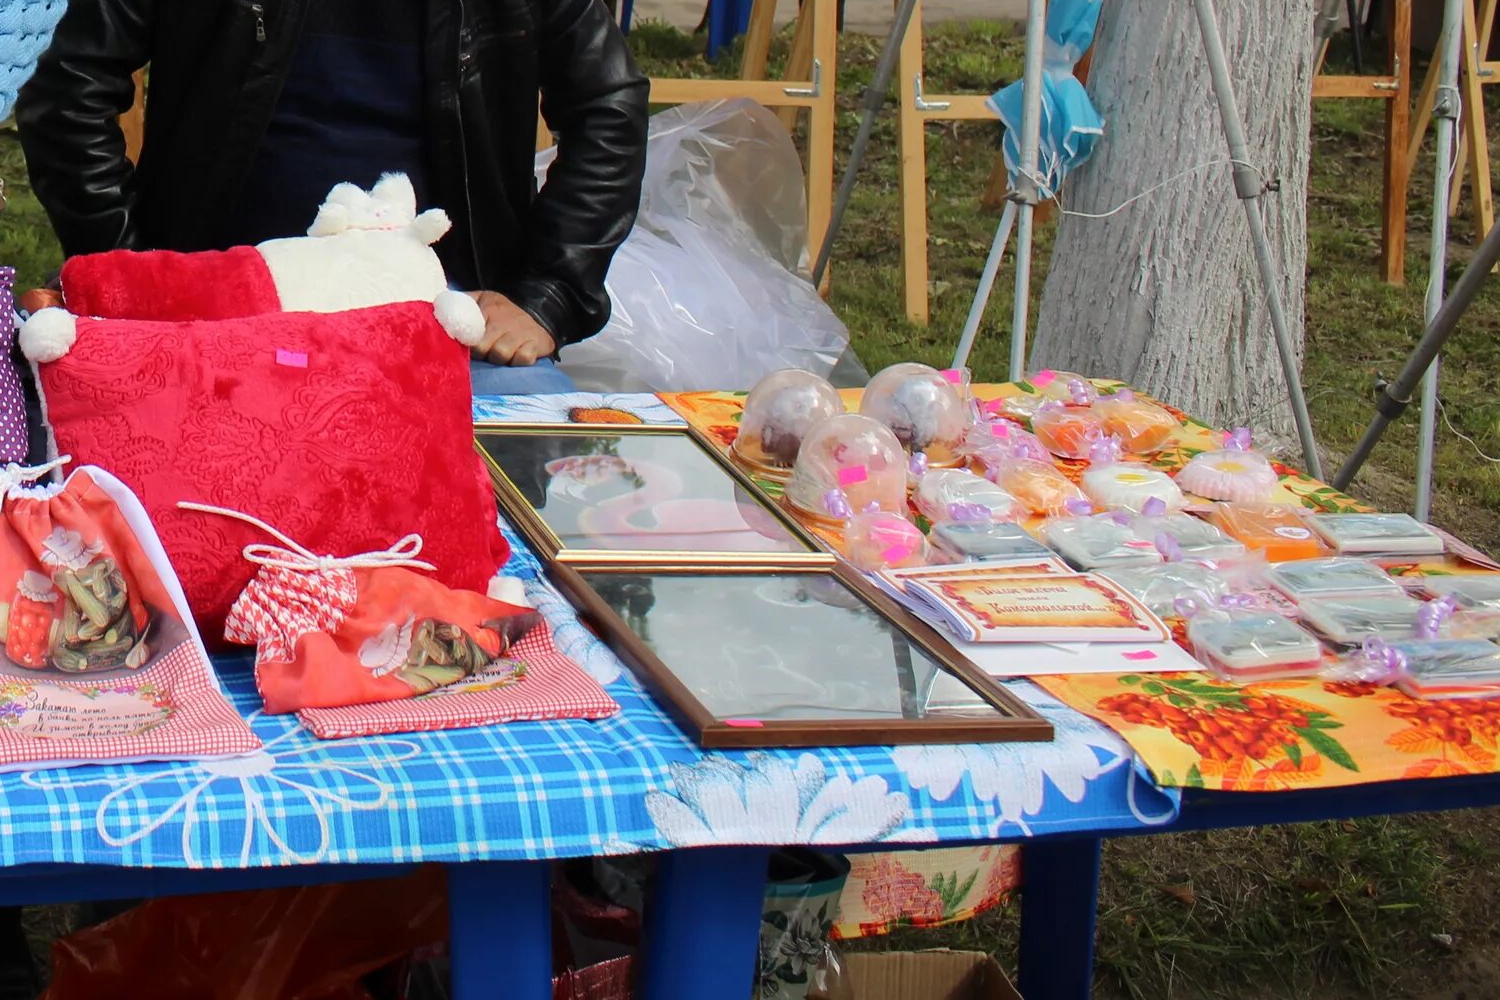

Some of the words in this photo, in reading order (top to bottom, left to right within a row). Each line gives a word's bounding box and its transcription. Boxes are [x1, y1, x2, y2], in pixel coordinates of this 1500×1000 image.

[25, 690, 77, 714] Закатаю
[38, 713, 43, 722] в
[47, 713, 77, 722] банки
[49, 724, 85, 733] зимою
[88, 721, 94, 730] в
